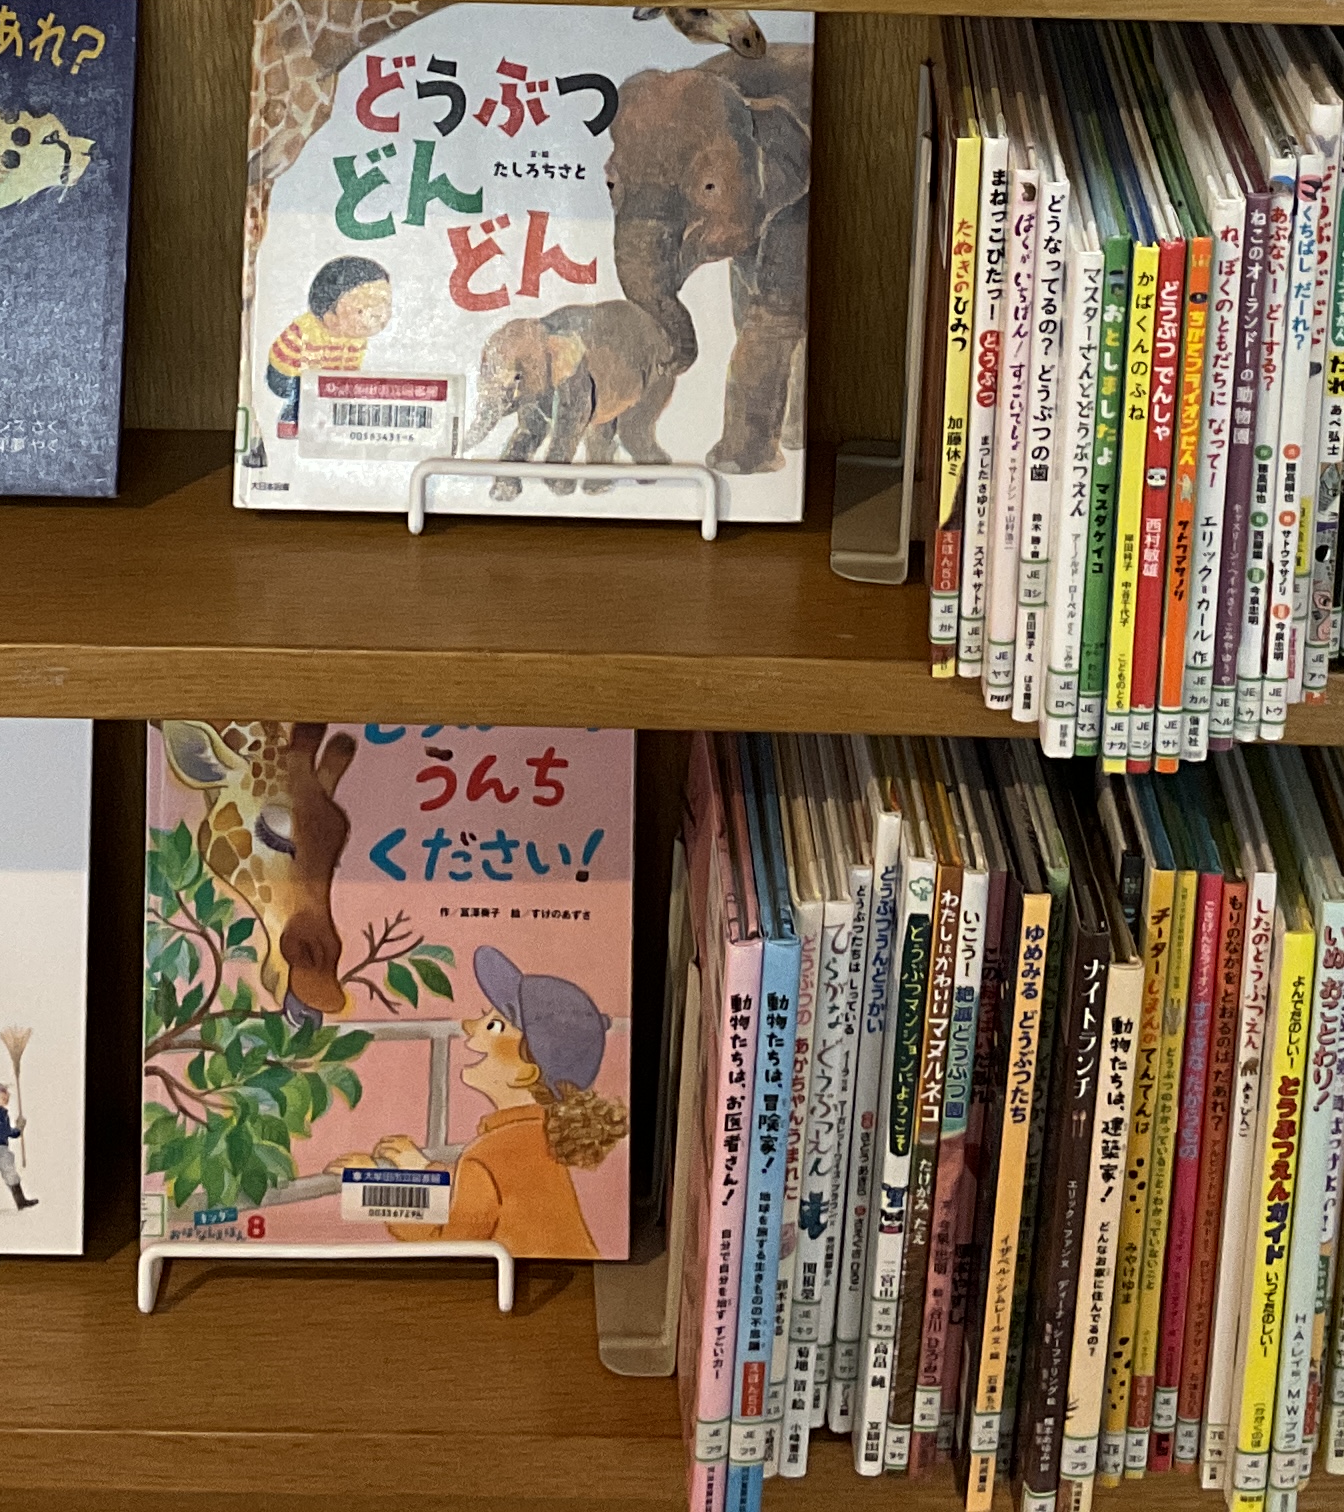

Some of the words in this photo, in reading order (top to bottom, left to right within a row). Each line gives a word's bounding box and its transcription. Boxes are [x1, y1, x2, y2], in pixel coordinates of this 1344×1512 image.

[355, 53, 620, 138] どうぶつ
[332, 139, 484, 242] どん
[493, 161, 587, 181] たしろちさと
[447, 209, 598, 313] どん
[1038, 194, 1065, 356] どうなってるの?
[1297, 205, 1314, 272] くちばし
[949, 217, 974, 352] たぬきのひみつ
[1156, 280, 1179, 359] どうぶつ
[1292, 282, 1312, 351] だーれ?
[1127, 271, 1154, 420] かばくんのふね
[1209, 257, 1241, 406] ぼくのともだちに
[1232, 208, 1267, 445] ねこのオーランドーの動物園
[977, 330, 1000, 407] どうぶつ
[1069, 268, 1103, 517] マスターさんとどうぶつえん
[1096, 304, 1124, 466] おとしましたよ
[1151, 365, 1174, 441] でんしゃ
[1030, 363, 1057, 482] どうぶつの歯
[1327, 404, 1344, 456] あべ弘士
[1142, 517, 1162, 578] 西村敏雄
[995, 651, 1008, 660] JE
[1191, 650, 1208, 665] 作
[1241, 687, 1256, 697] JE
[1078, 721, 1097, 732] マス
[1080, 703, 1093, 713] JE
[1164, 720, 1178, 730] JE
[1188, 694, 1208, 705] カル
[415, 744, 571, 814] うんち
[1107, 740, 1127, 751] ナカ
[1131, 741, 1152, 751] ニシ
[368, 827, 606, 883] ください!
[824, 924, 852, 1031] ひらがな
[1020, 926, 1045, 1000] ゆめみる
[1245, 898, 1270, 1051] したのどうぶつえん
[728, 993, 753, 1089] 動物たちは、
[764, 991, 790, 1089] 動物たちは、
[1010, 1009, 1038, 1125] どうぶつたち
[1073, 958, 1105, 1100] ナイトランチ
[1106, 1016, 1134, 1112] 動物たちは、
[1311, 977, 1344, 1112] おことわり!
[721, 1095, 747, 1207] お医者さん!
[759, 1093, 786, 1175] 冒険家!
[1265, 1075, 1303, 1267] どうぶつえんガイド
[247, 1215, 266, 1239] 8
